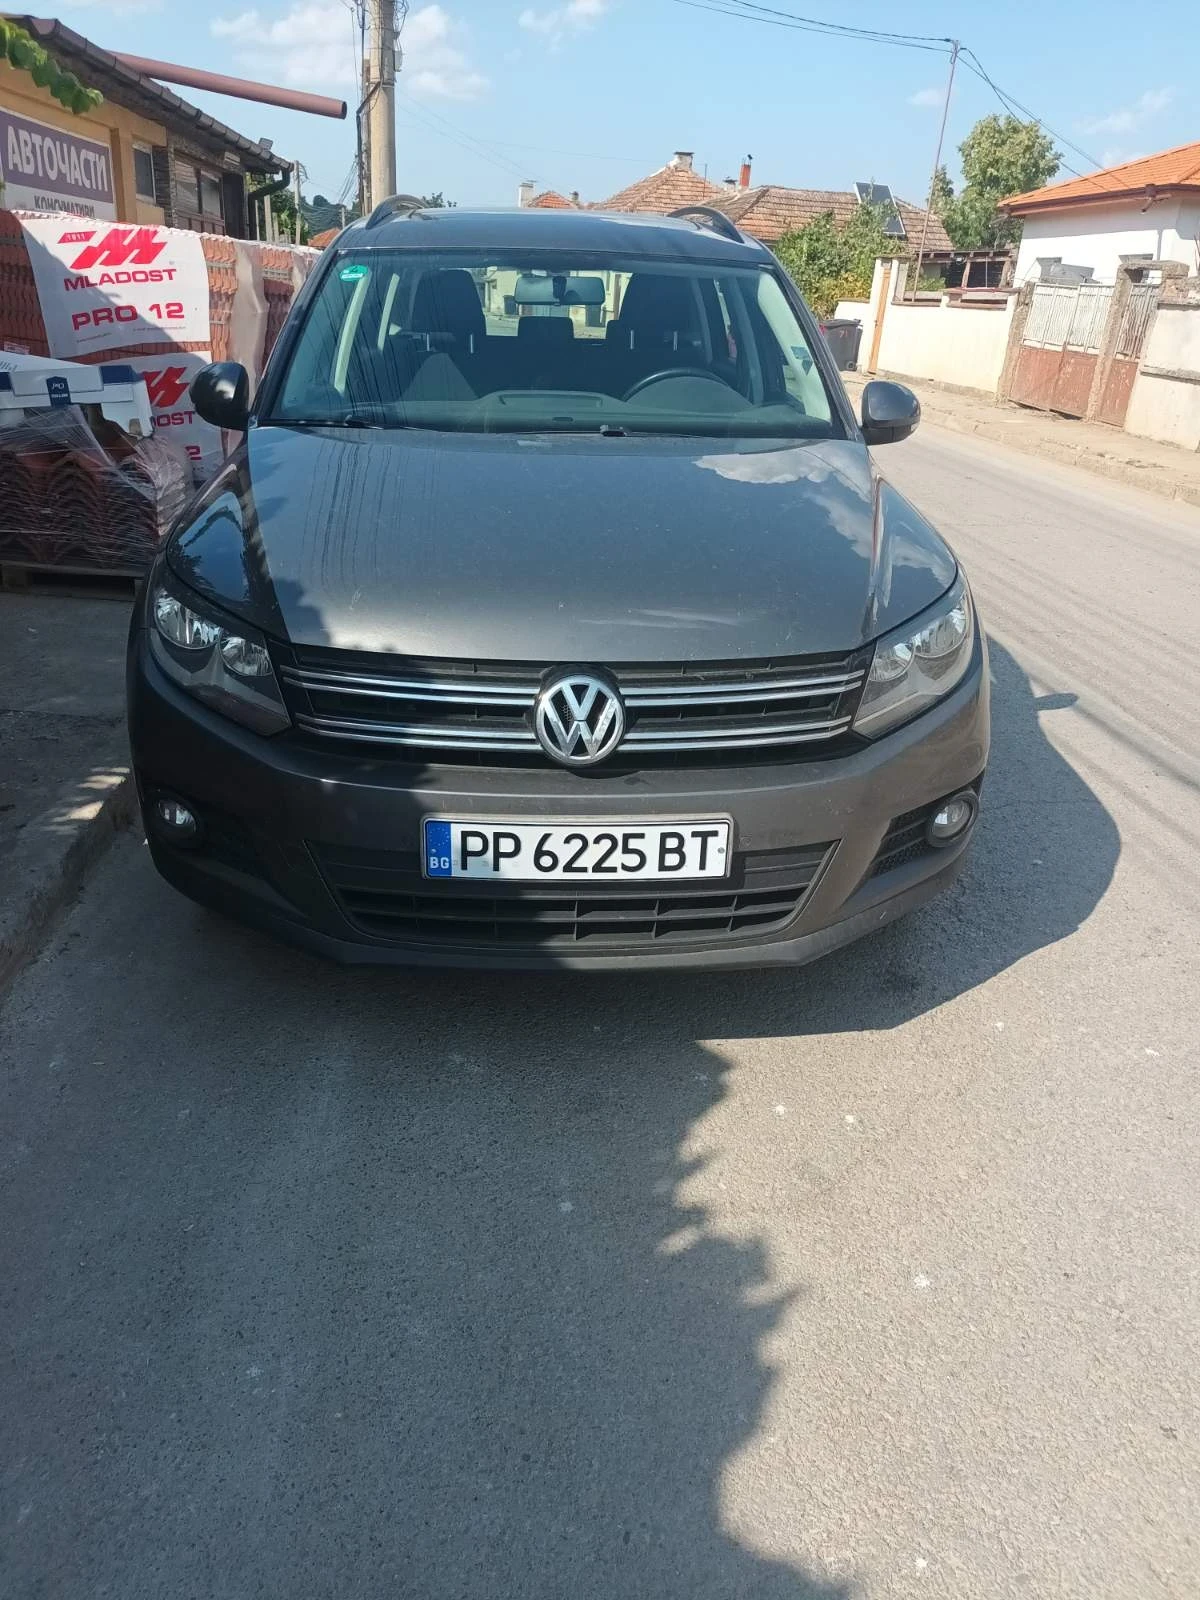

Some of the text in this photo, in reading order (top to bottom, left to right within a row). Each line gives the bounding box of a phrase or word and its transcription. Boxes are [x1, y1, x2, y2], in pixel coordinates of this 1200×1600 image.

[7, 125, 108, 192] АВТОЧАСТИ
[64, 269, 177, 291] MLADOST
[71, 302, 185, 331] PRO 12
[538, 676, 623, 762] VW
[429, 856, 450, 869] BG
[460, 830, 719, 873] PP 6225 BT
